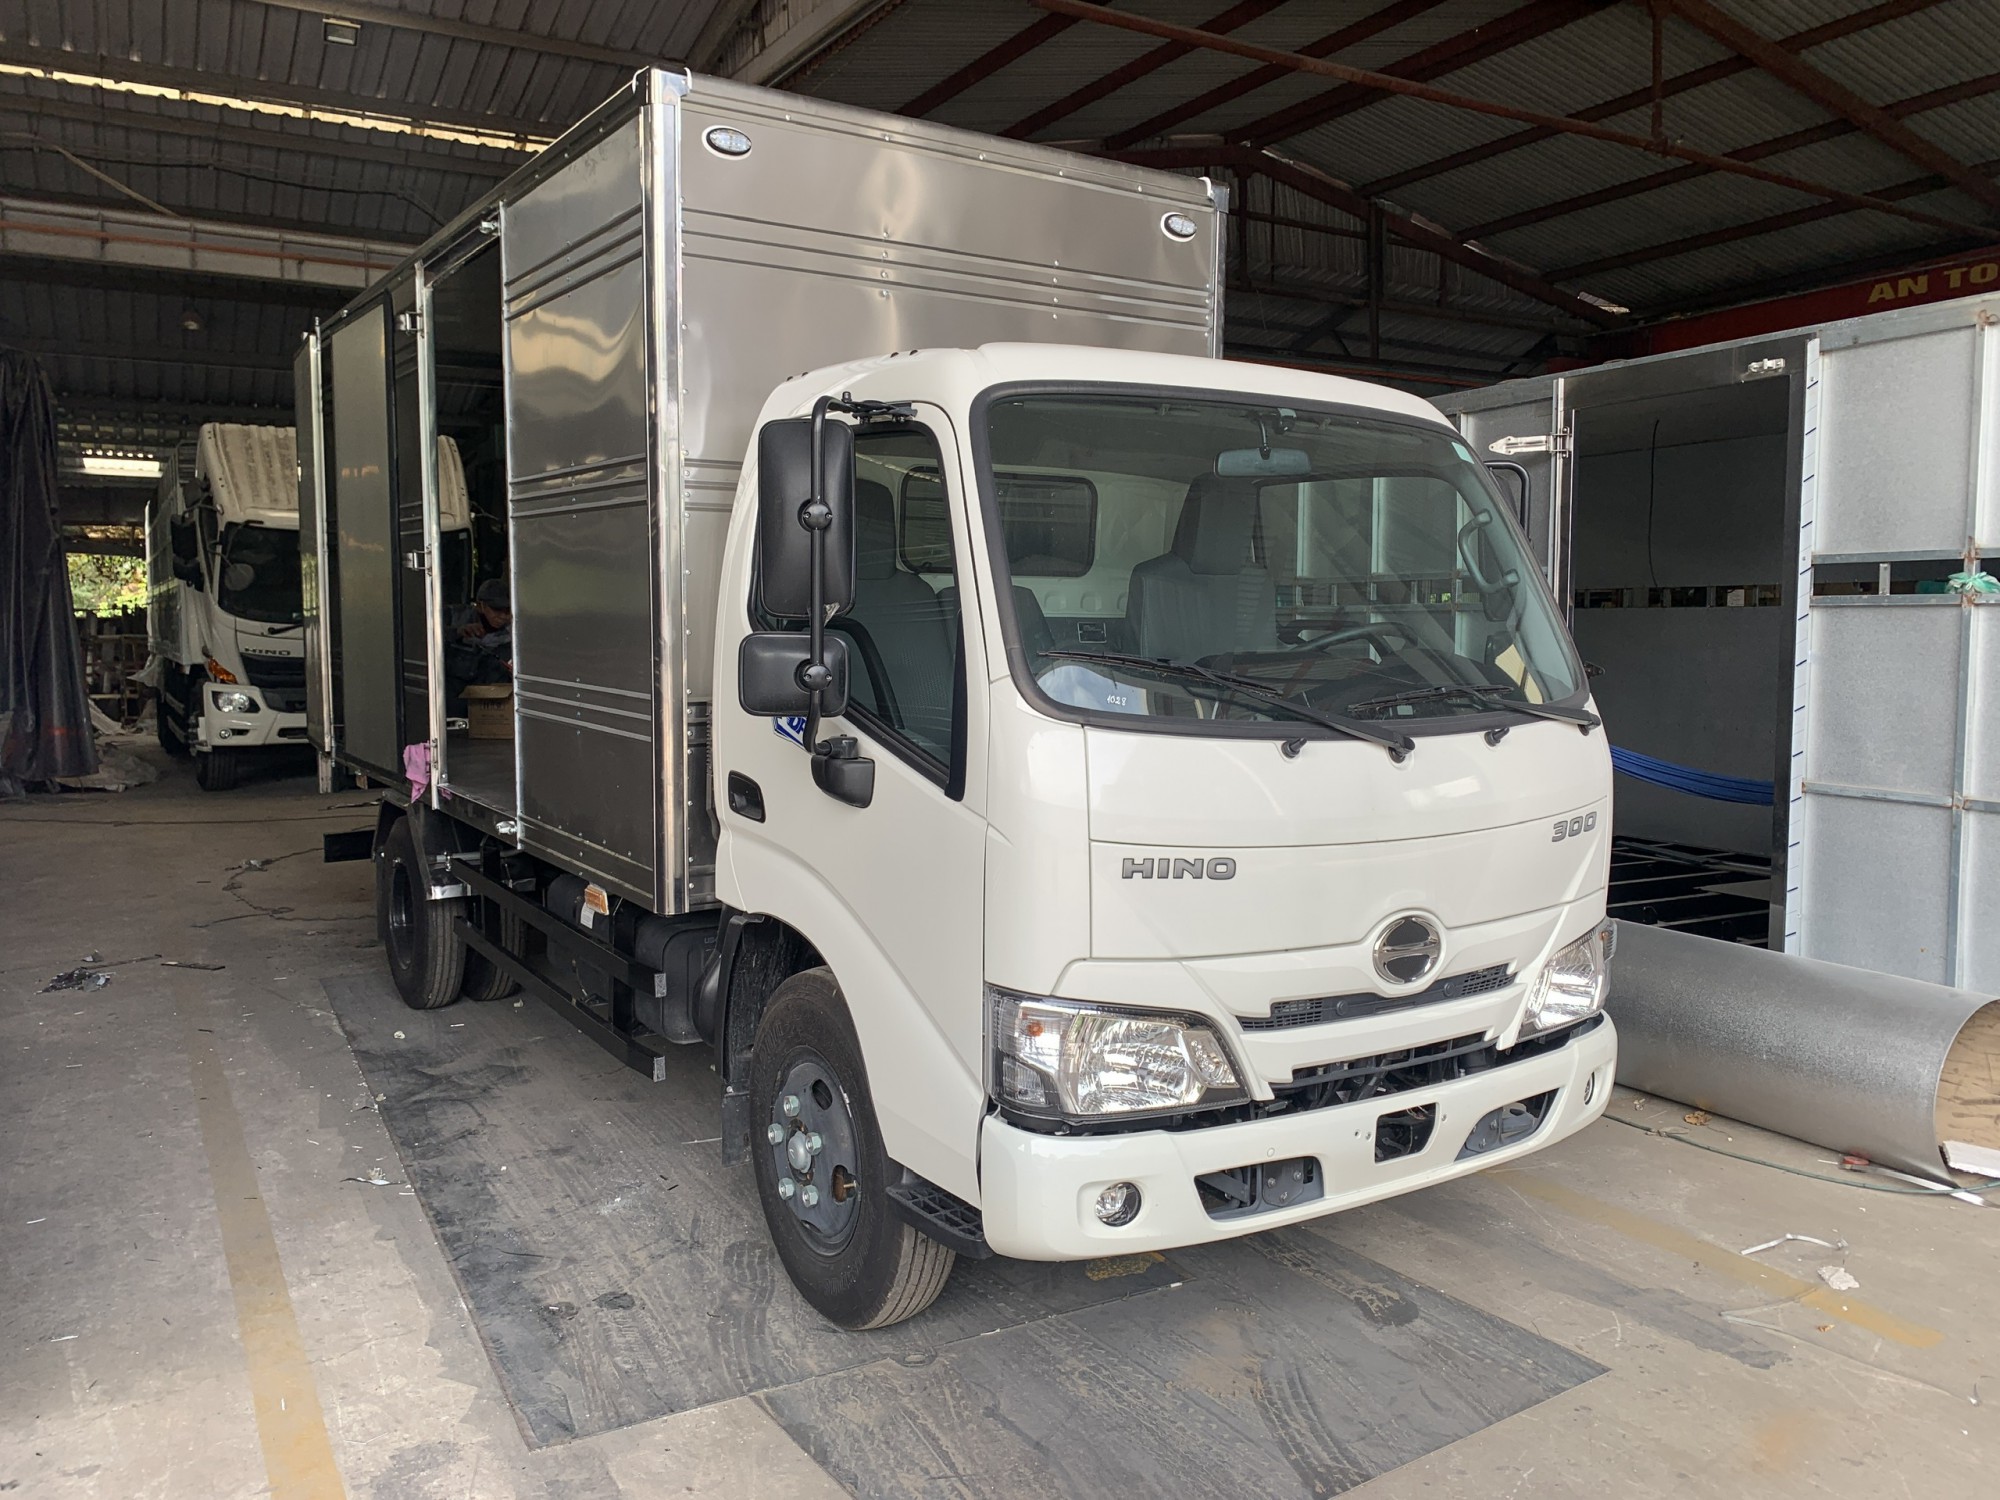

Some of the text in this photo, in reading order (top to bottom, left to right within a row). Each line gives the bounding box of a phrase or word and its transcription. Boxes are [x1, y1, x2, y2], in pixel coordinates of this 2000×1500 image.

[1868, 263, 1999, 303] AN TO
[244, 647, 291, 656] HINO
[1551, 811, 1597, 843] 300
[1121, 856, 1237, 881] HINO
